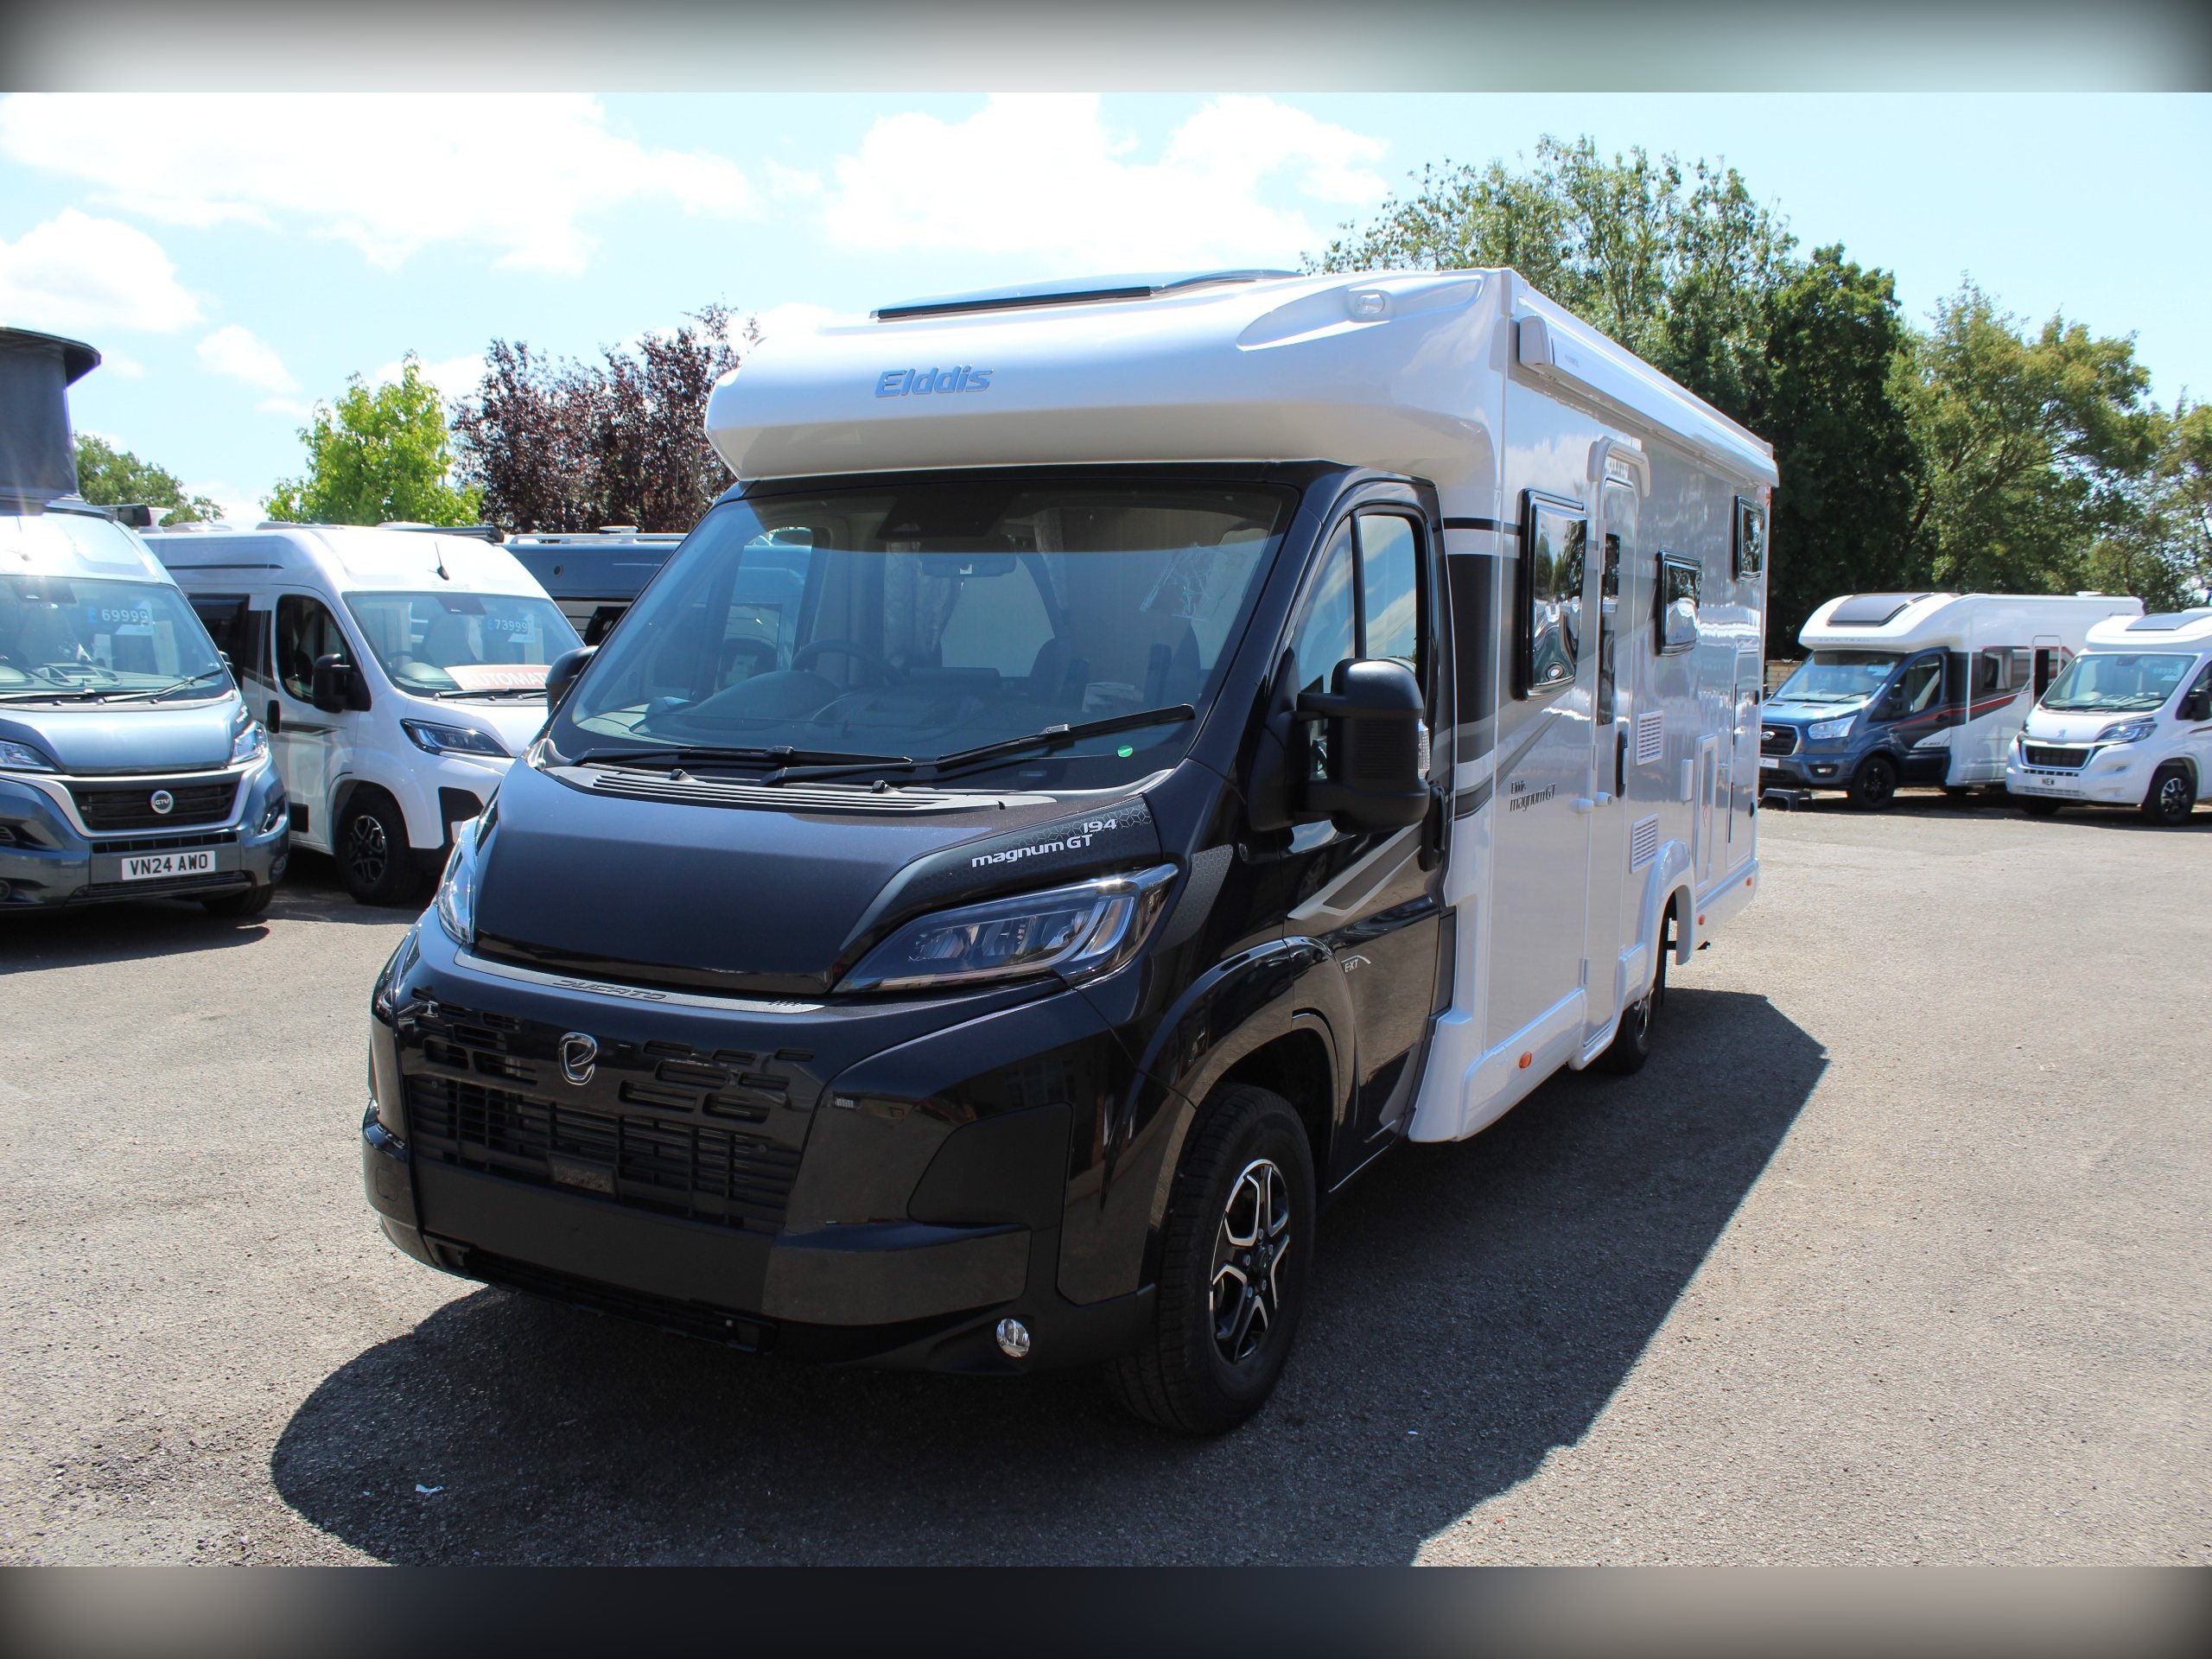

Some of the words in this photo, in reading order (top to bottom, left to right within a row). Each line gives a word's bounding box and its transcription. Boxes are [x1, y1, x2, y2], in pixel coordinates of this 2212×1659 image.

[875, 365, 994, 397] Elddis
[1083, 818, 1117, 835] 194
[971, 841, 1065, 868] magnum
[1066, 833, 1093, 849] GT
[130, 856, 172, 876] VN24
[178, 854, 208, 872] AWO
[553, 980, 667, 1000] DUCATO
